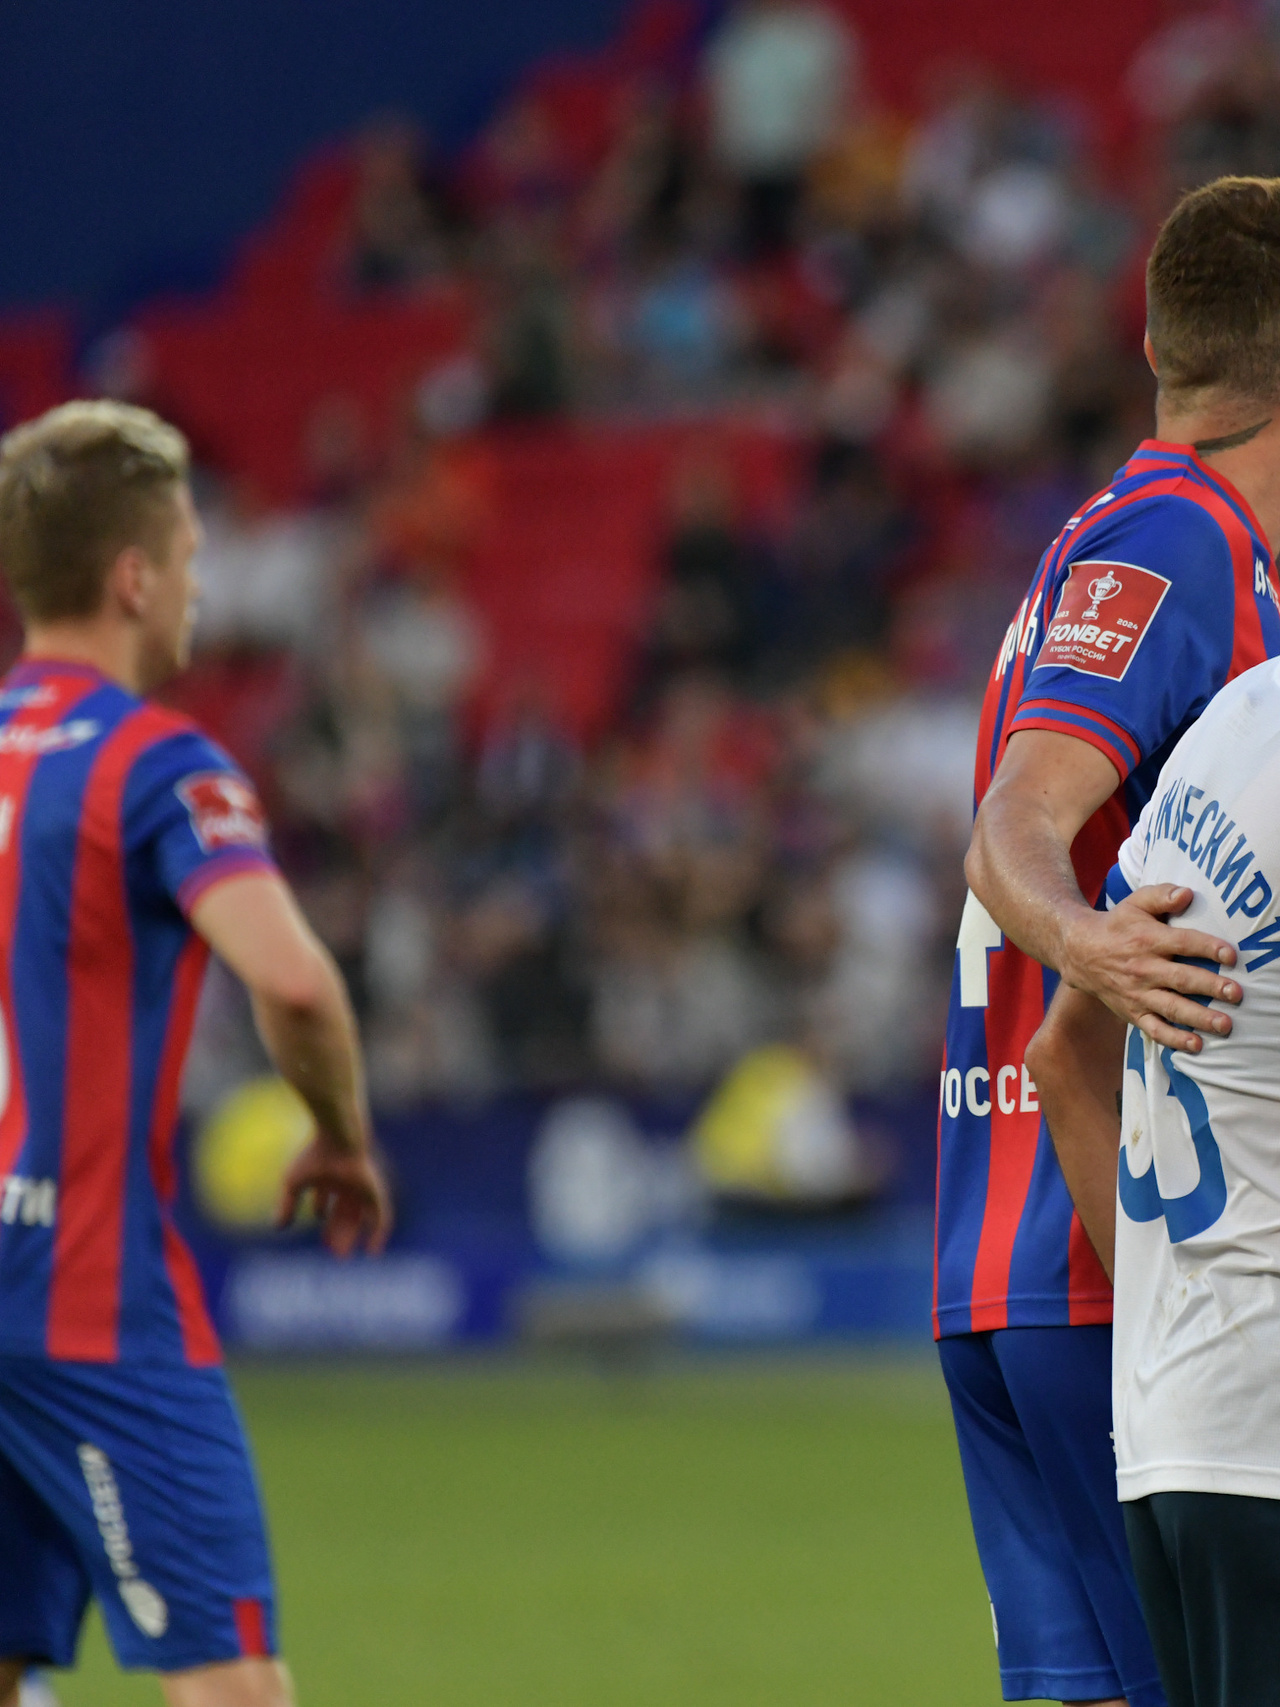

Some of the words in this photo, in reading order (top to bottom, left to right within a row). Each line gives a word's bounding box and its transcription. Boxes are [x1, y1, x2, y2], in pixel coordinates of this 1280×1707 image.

[1116, 618, 1139, 631] 2024
[1045, 623, 1133, 653] FONBET
[1071, 645, 1107, 662] РОССИИ
[939, 1063, 1040, 1119] ОССЕ
